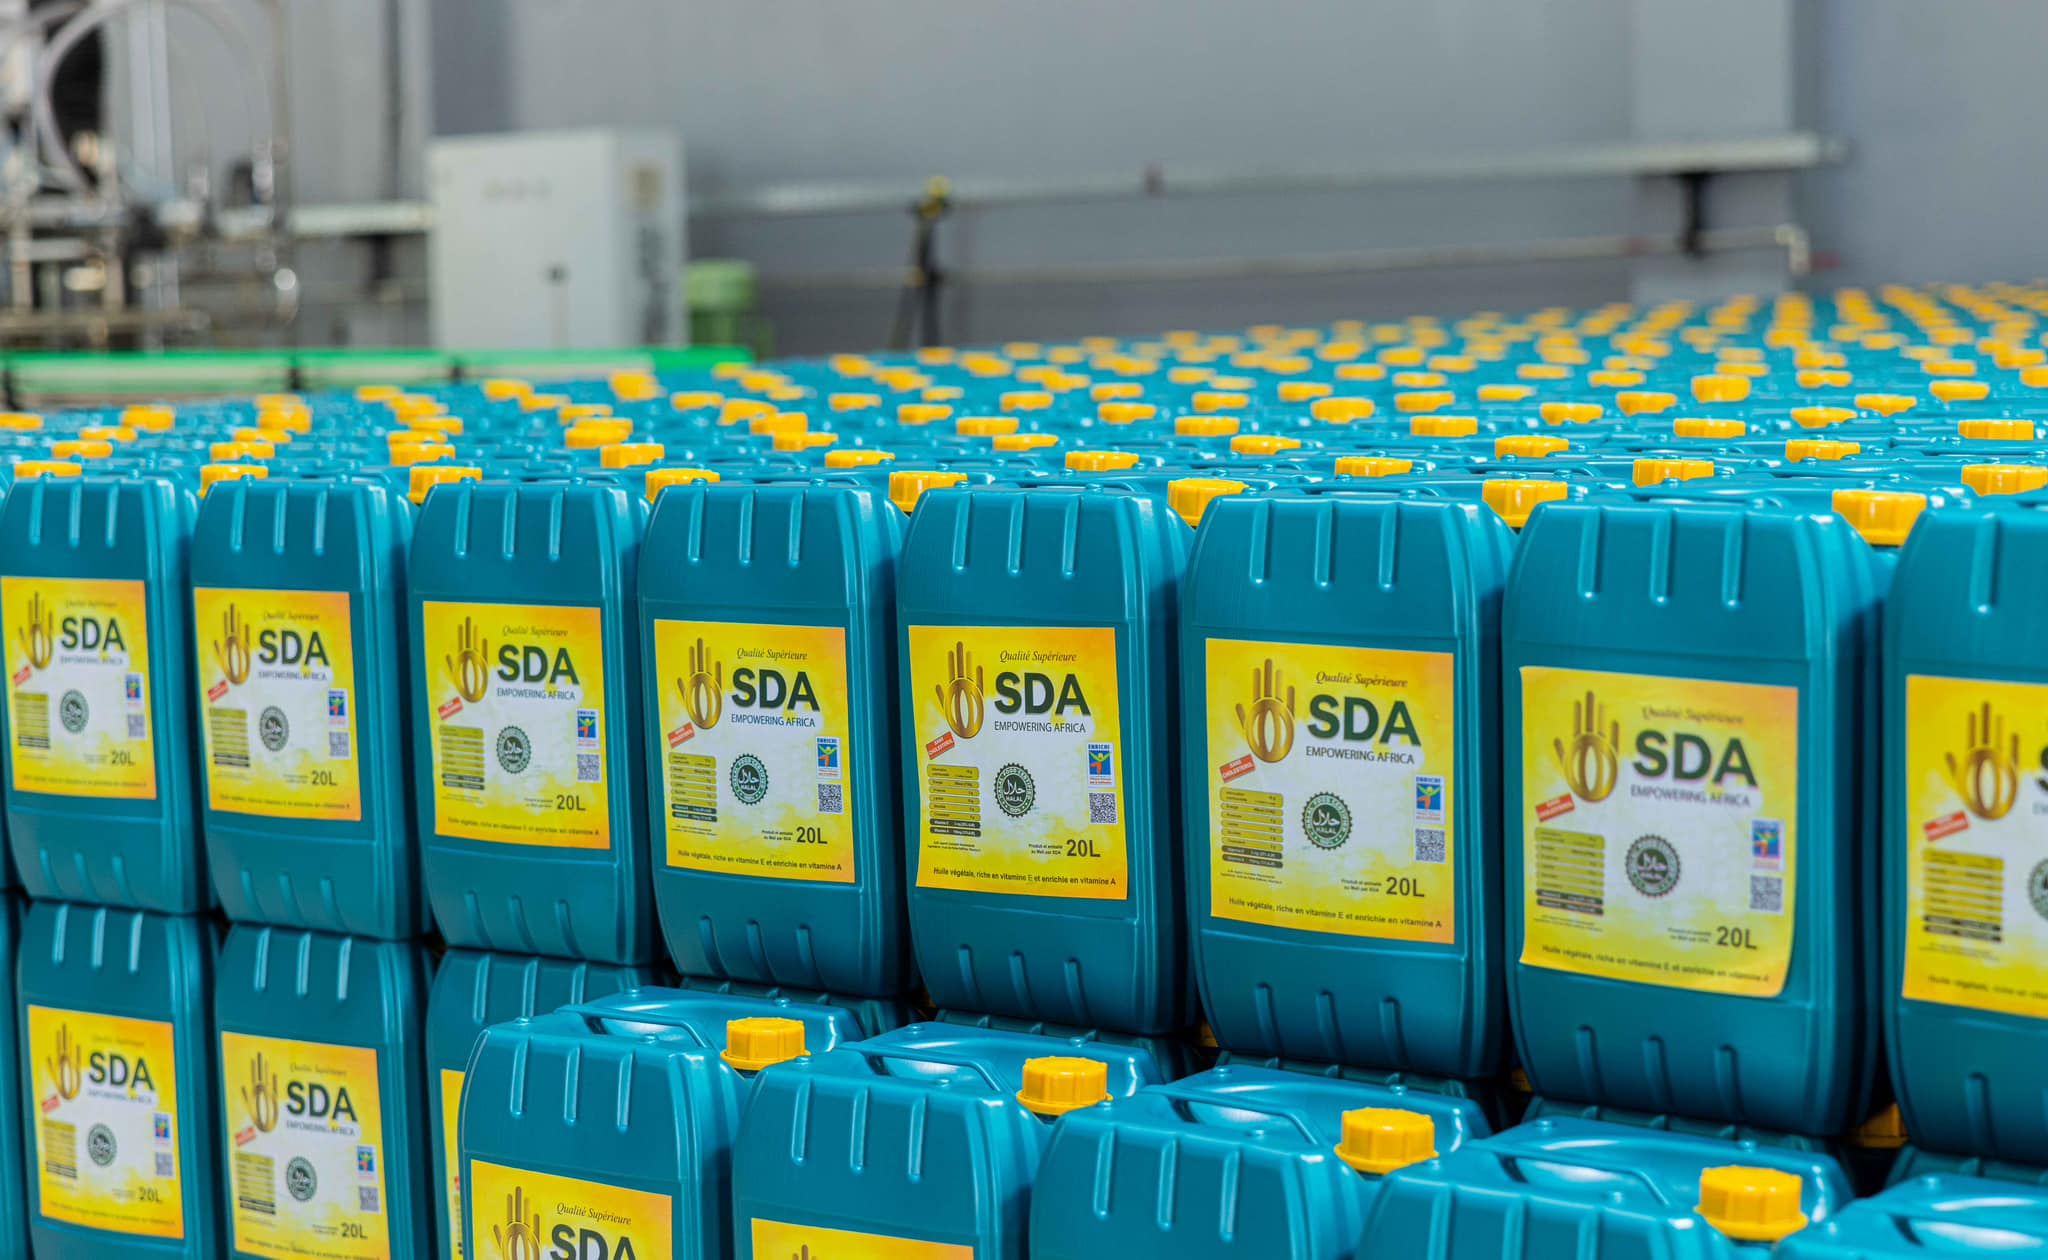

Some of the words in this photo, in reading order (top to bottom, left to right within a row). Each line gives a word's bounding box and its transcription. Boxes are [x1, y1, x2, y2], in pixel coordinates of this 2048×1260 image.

[61, 617, 126, 651] SDA
[258, 630, 330, 666] SDA
[736, 648, 765, 660] Qualité
[766, 649, 808, 661] Supérieure
[1000, 650, 1031, 662] Qualité
[1032, 651, 1077, 664] Supérieure
[496, 644, 580, 686] SDA
[731, 667, 820, 712] SDA
[1316, 671, 1352, 684] Qualité
[1354, 673, 1408, 688] Supérieure
[496, 687, 546, 700] EMPOWERING
[548, 690, 576, 701] AFRICA
[994, 672, 1092, 716] SDA
[731, 714, 784, 726] EMPOWERING
[786, 716, 816, 728] AFRICA
[994, 720, 1052, 733] EMPOWERING
[1054, 722, 1086, 734] AFRICA
[1307, 694, 1422, 746] SDA
[1306, 746, 1375, 762] EMPOWERING
[1377, 751, 1415, 764] AFRICA
[1632, 730, 1758, 788] SDA
[311, 771, 338, 786] 20L
[556, 794, 586, 812] 20L
[796, 826, 828, 844] 20L
[1066, 839, 1101, 858] 20L
[1000, 872, 1026, 880] vitamine
[1042, 875, 1068, 884] enrichie
[1080, 876, 1109, 885] vitamine
[1111, 878, 1117, 886] A
[1386, 876, 1425, 898] 20L
[1305, 908, 1336, 918] vitamine
[1354, 914, 1386, 923] enrichie
[1400, 916, 1434, 928] vitamine
[1436, 920, 1442, 928] A
[1716, 926, 1758, 950] 20L
[88, 1052, 155, 1091] SDA
[286, 1080, 358, 1122] SDA
[556, 1202, 586, 1217] Qualité
[588, 1208, 632, 1226] Supérieure
[340, 1222, 368, 1240] 20L
[550, 1224, 637, 1260] SDA
